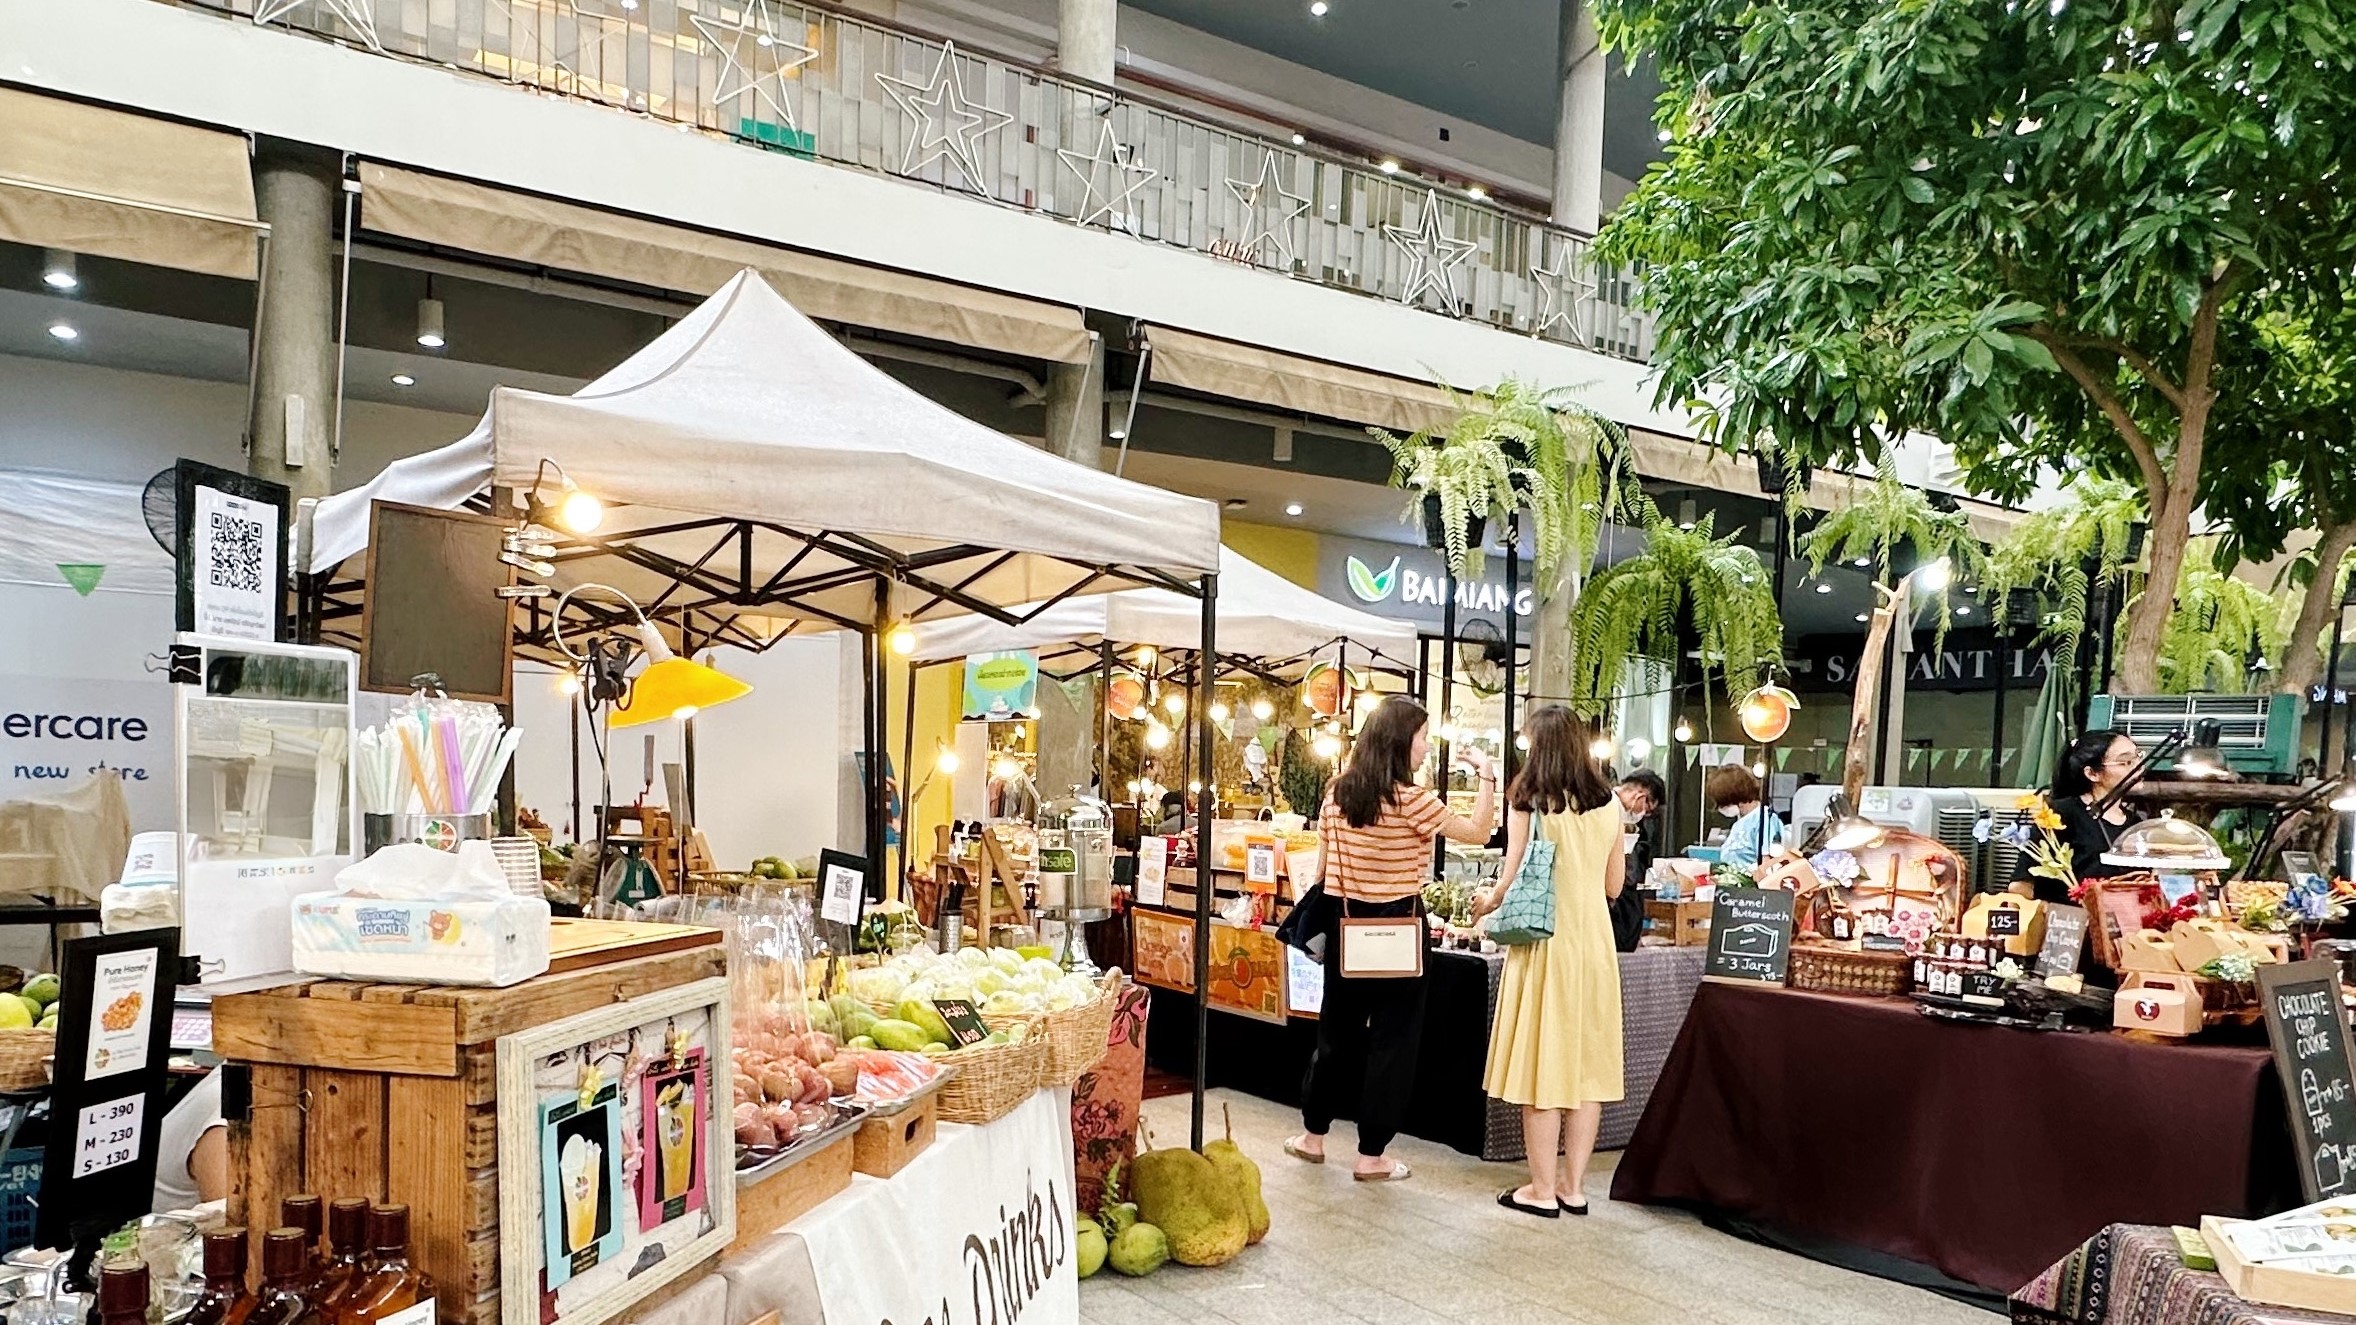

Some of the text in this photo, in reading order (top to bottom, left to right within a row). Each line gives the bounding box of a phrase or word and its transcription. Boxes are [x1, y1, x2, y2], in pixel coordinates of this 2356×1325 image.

[1402, 569, 1532, 616] BAIMIANG
[1827, 648, 2052, 682] SANTHA
[3, 713, 147, 742] ercare
[14, 765, 69, 779] new
[1719, 892, 1766, 908] Caramel
[104, 968, 122, 976] Pure
[1728, 957, 1738, 970] 3
[1741, 958, 1772, 973] Jars
[1973, 975, 1996, 986] TRY
[1976, 985, 1994, 995] ME
[2278, 991, 2330, 1020] CHOCOLATE
[2295, 1016, 2316, 1037] CHIP
[2296, 1031, 2331, 1060] COOKIE
[89, 1113, 97, 1125] L
[109, 1102, 134, 1120] 390
[85, 1137, 96, 1151] M
[109, 1127, 134, 1144] 230
[83, 1160, 93, 1173] S
[105, 1148, 129, 1166] 130
[963, 1166, 1065, 1325] Drinks
